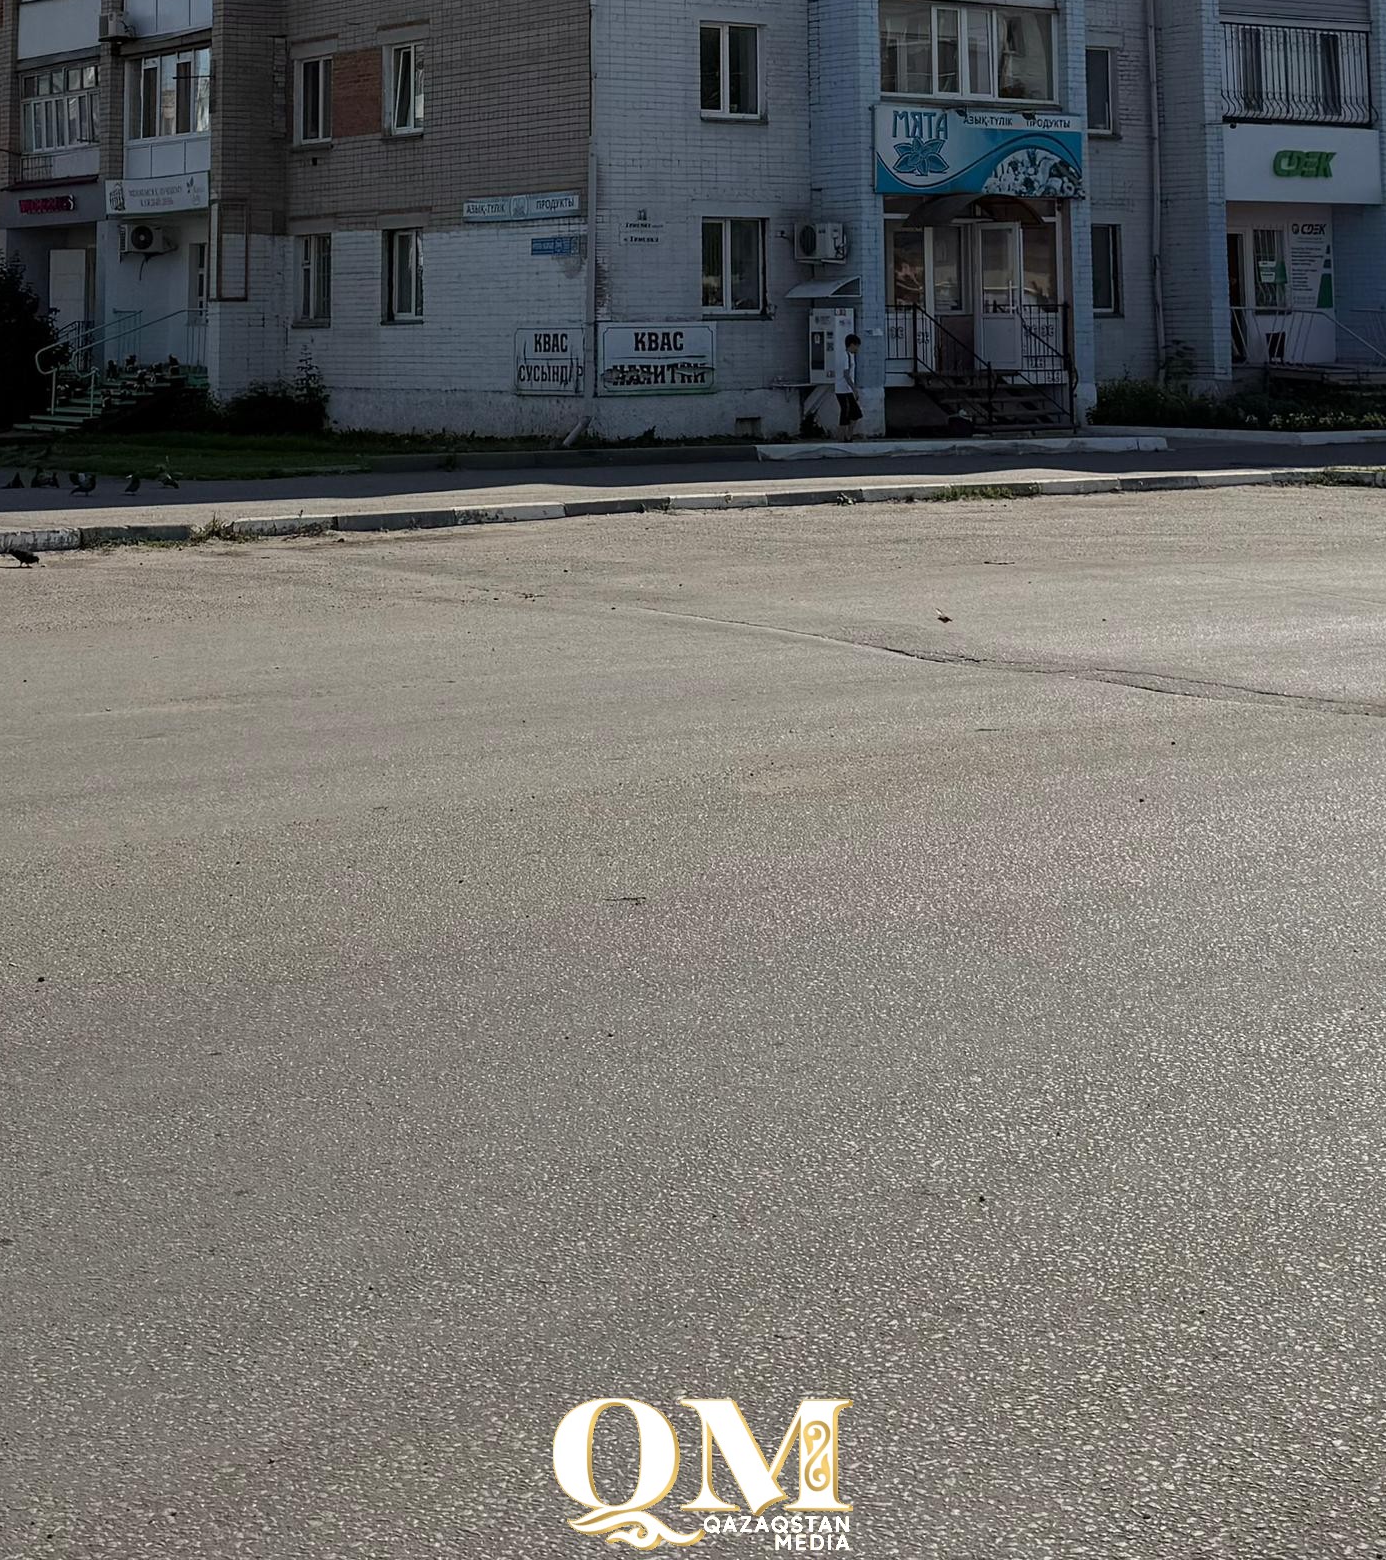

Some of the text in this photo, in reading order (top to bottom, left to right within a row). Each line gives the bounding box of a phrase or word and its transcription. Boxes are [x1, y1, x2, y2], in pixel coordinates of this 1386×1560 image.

[892, 110, 948, 140] МЯТА
[1273, 150, 1337, 178] CDEK
[536, 197, 575, 212] ПРОДУКТЫ
[1301, 223, 1327, 235] CDEK
[534, 333, 568, 353] КВАС
[634, 332, 684, 352] КВАС
